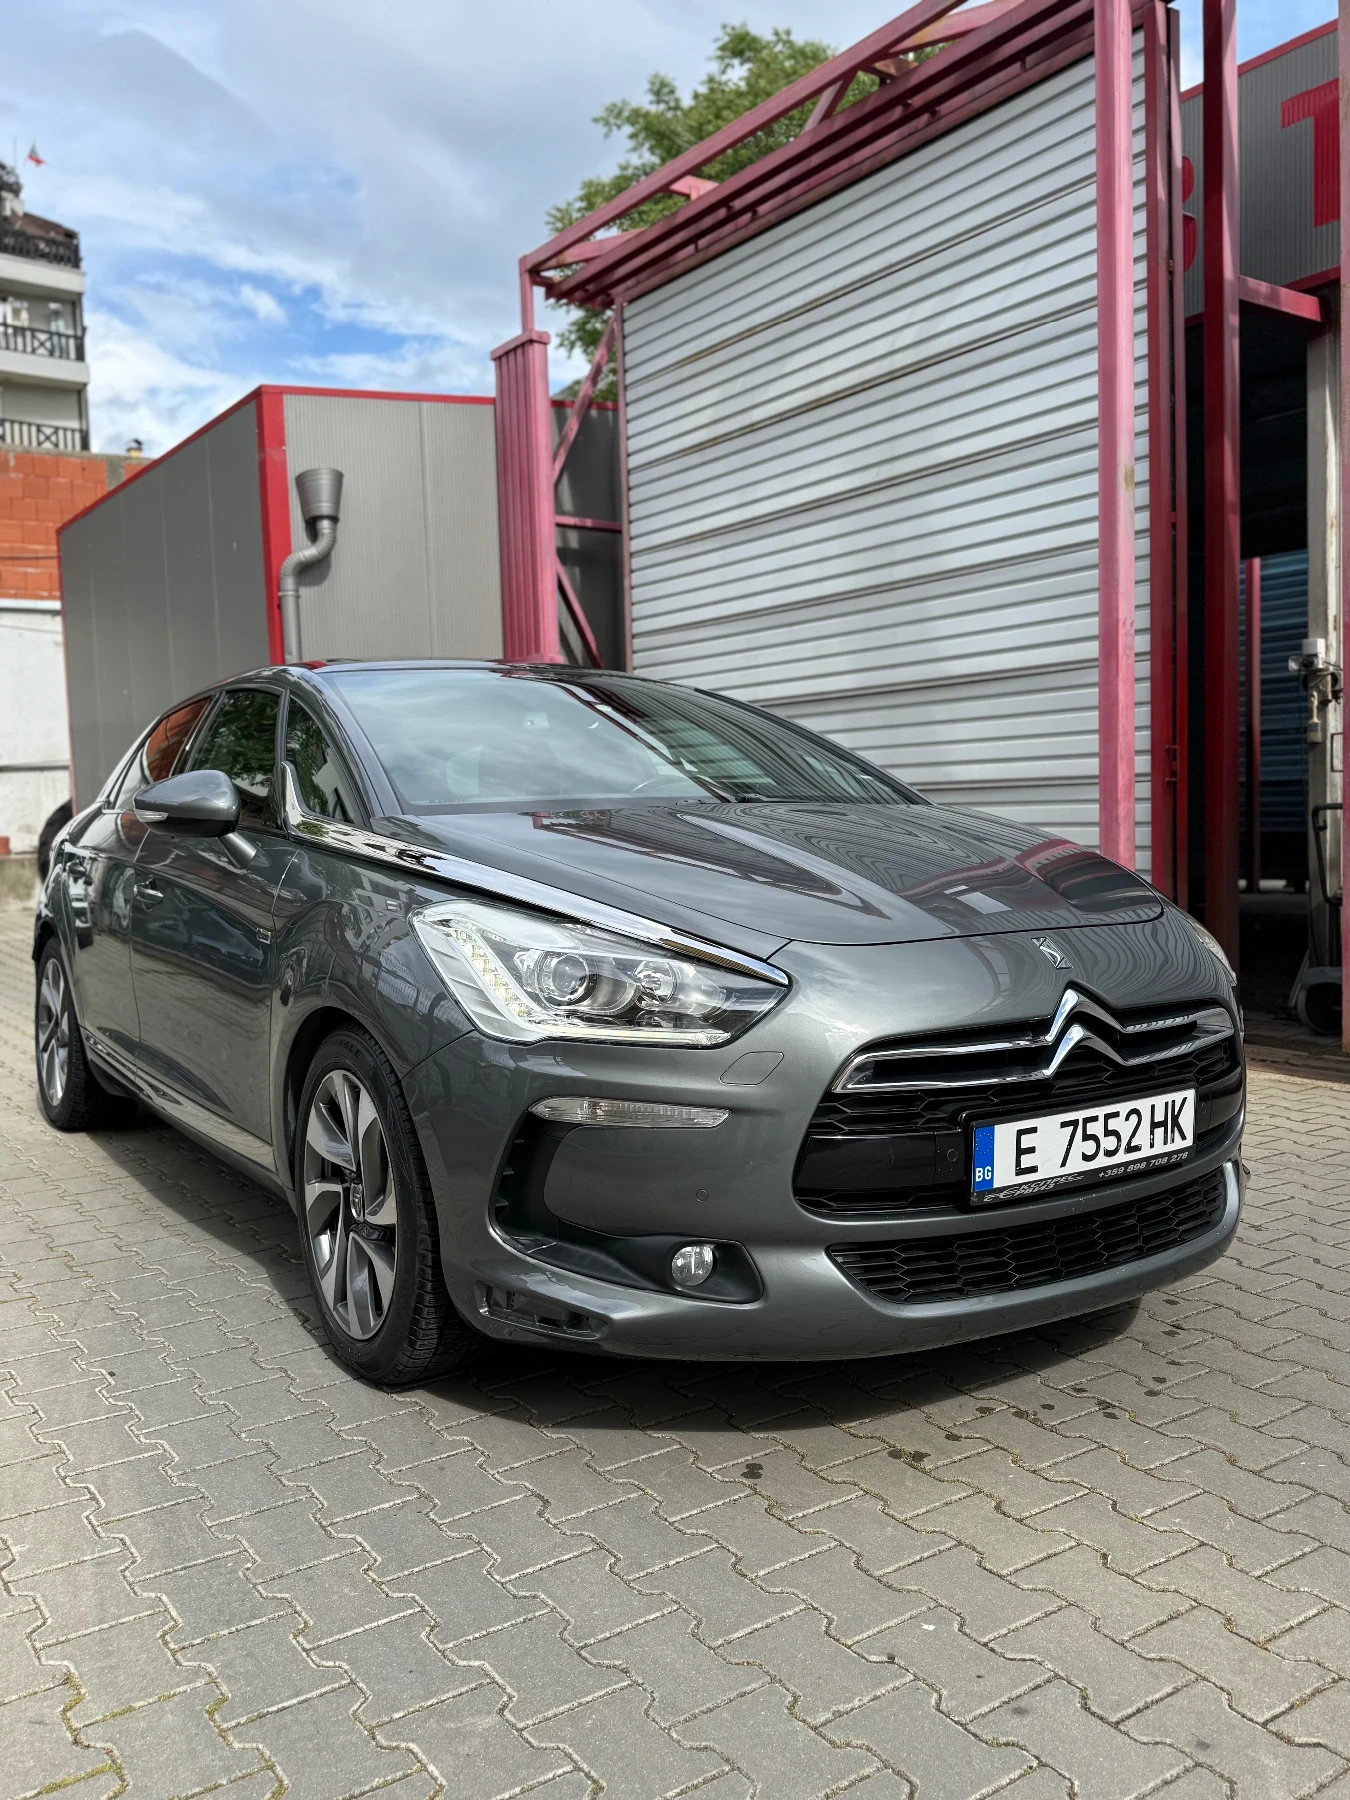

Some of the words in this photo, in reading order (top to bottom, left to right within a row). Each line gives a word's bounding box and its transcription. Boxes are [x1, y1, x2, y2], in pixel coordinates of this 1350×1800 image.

[1015, 1126, 1038, 1176] E
[1059, 1107, 1143, 1169] 7552
[1150, 1096, 1188, 1149] HK
[975, 1165, 992, 1182] BG
[1098, 1166, 1124, 1178] +359
[1127, 1161, 1146, 1172] 898
[1149, 1156, 1168, 1167] 708
[1169, 1151, 1189, 1163] 278
